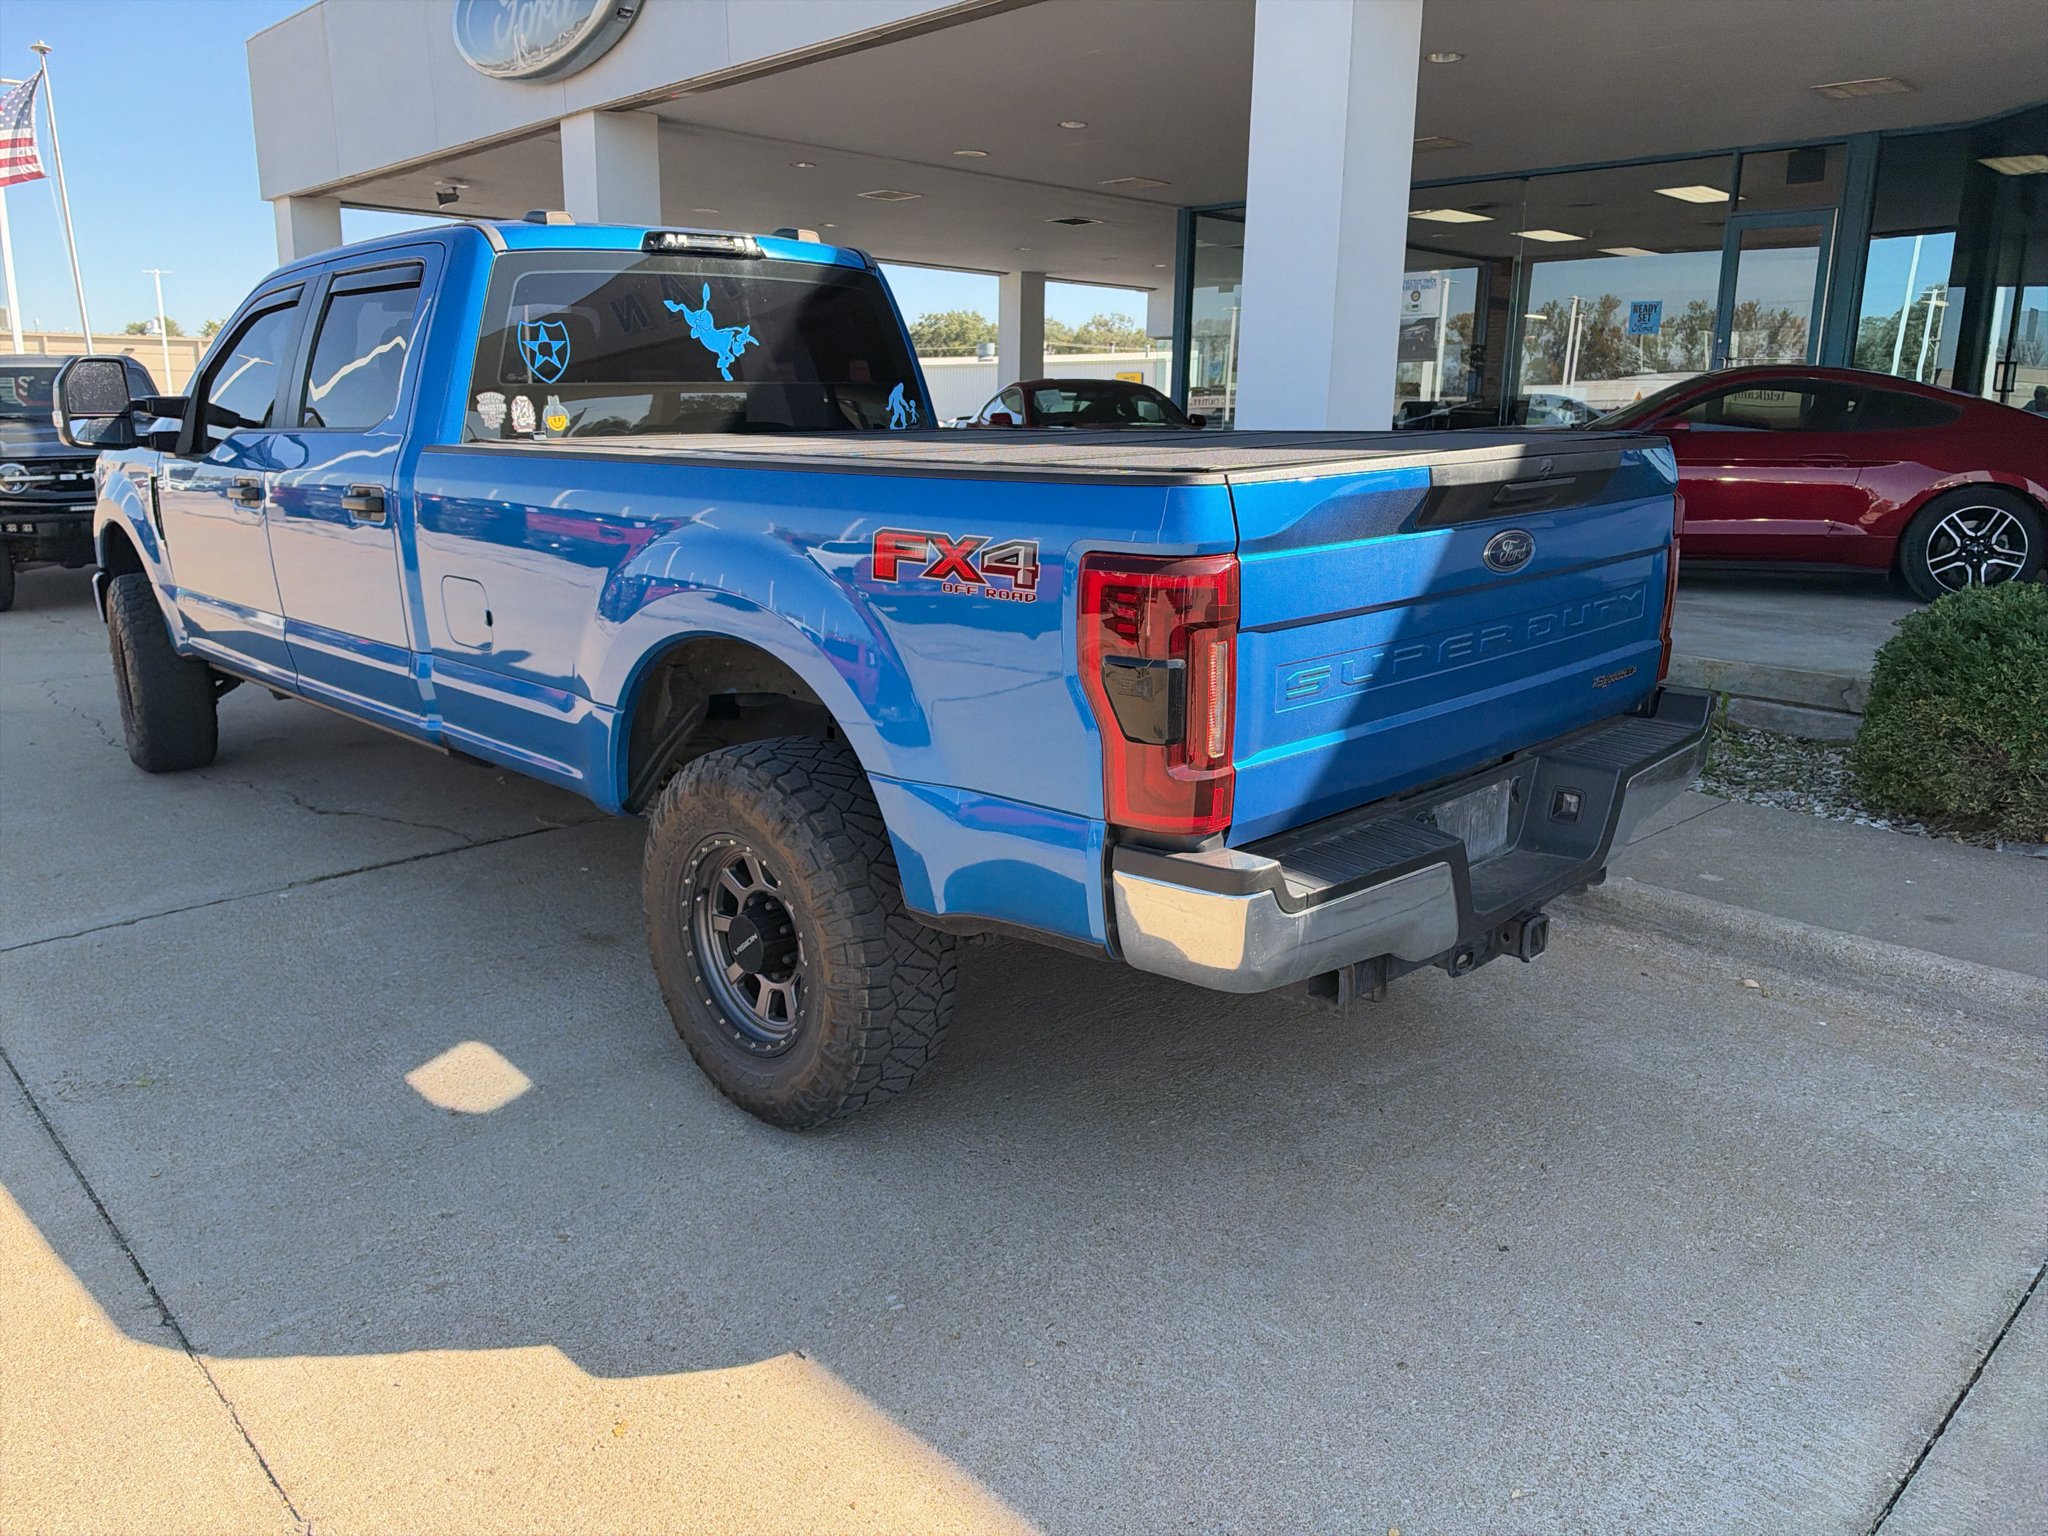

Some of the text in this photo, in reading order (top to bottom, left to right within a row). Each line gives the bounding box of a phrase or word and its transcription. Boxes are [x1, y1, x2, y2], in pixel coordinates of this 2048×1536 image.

[1632, 303, 1658, 314] READY
[1637, 312, 1652, 323] SET
[872, 527, 1040, 592] FX4
[1500, 539, 1527, 563] Ford
[942, 582, 1038, 604] OFF ROAD
[1286, 589, 1642, 701] SUPER DUTY
